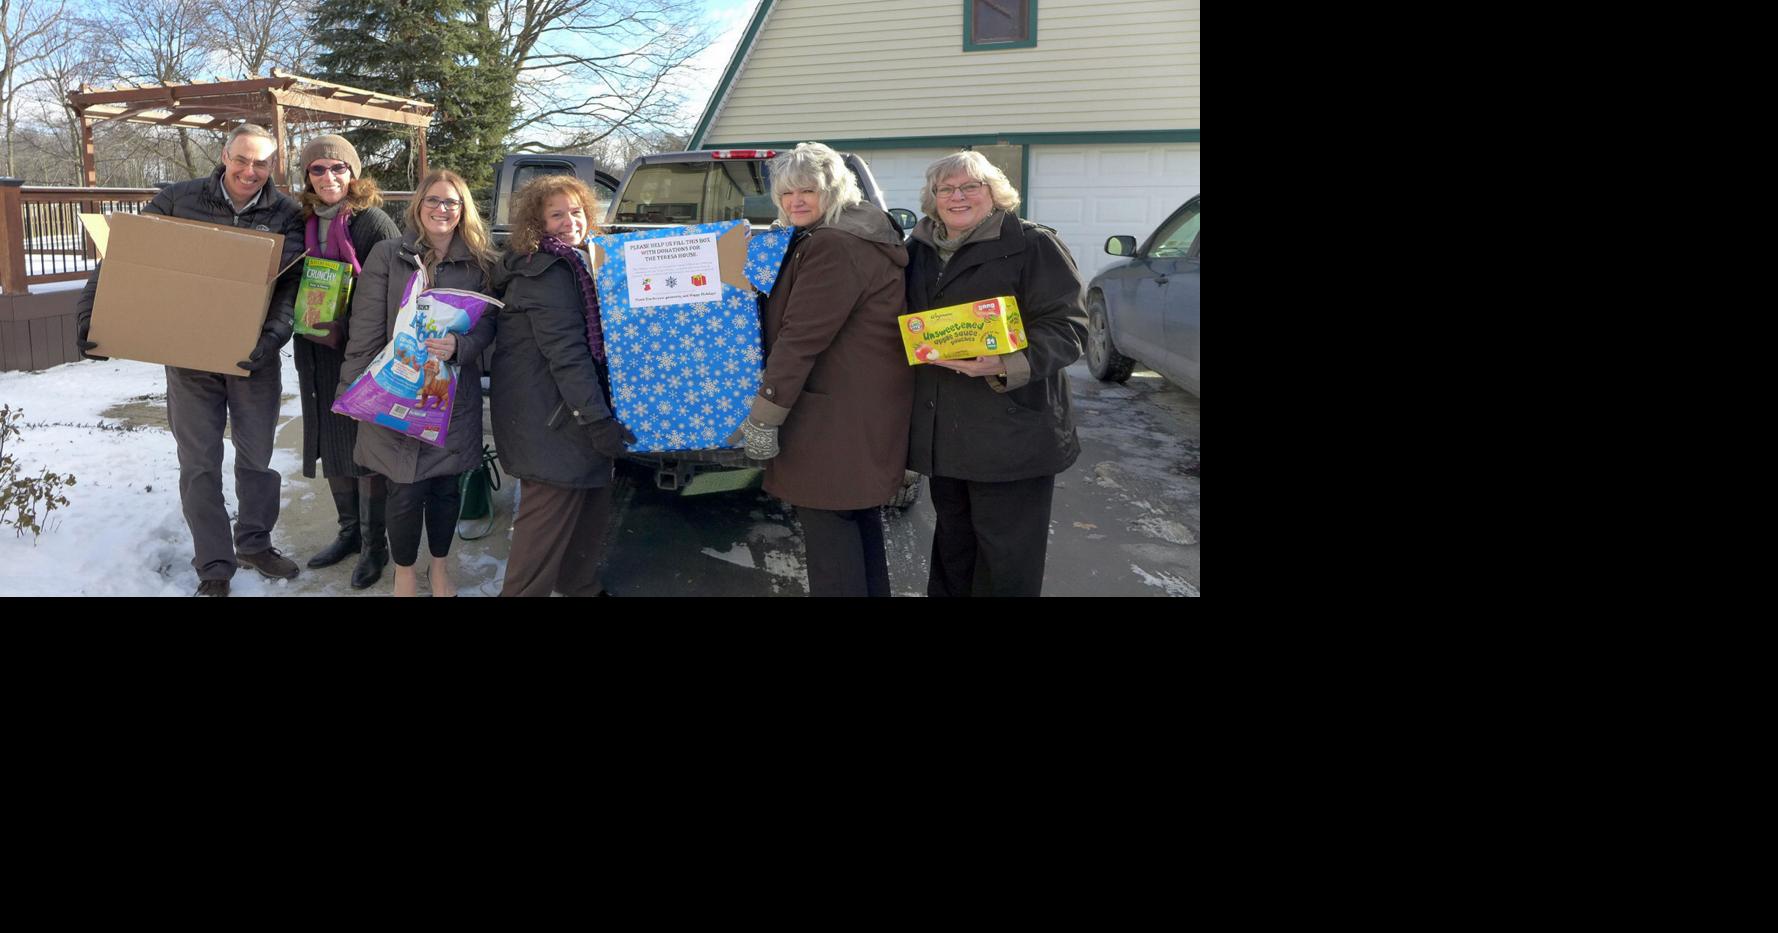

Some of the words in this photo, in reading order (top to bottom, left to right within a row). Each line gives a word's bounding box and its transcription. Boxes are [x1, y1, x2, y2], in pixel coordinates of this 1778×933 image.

[656, 246, 689, 255] DONATIONS
[306, 269, 337, 281] CRUNCHY
[923, 322, 985, 341] Unsweetened
[934, 335, 954, 345] apple
